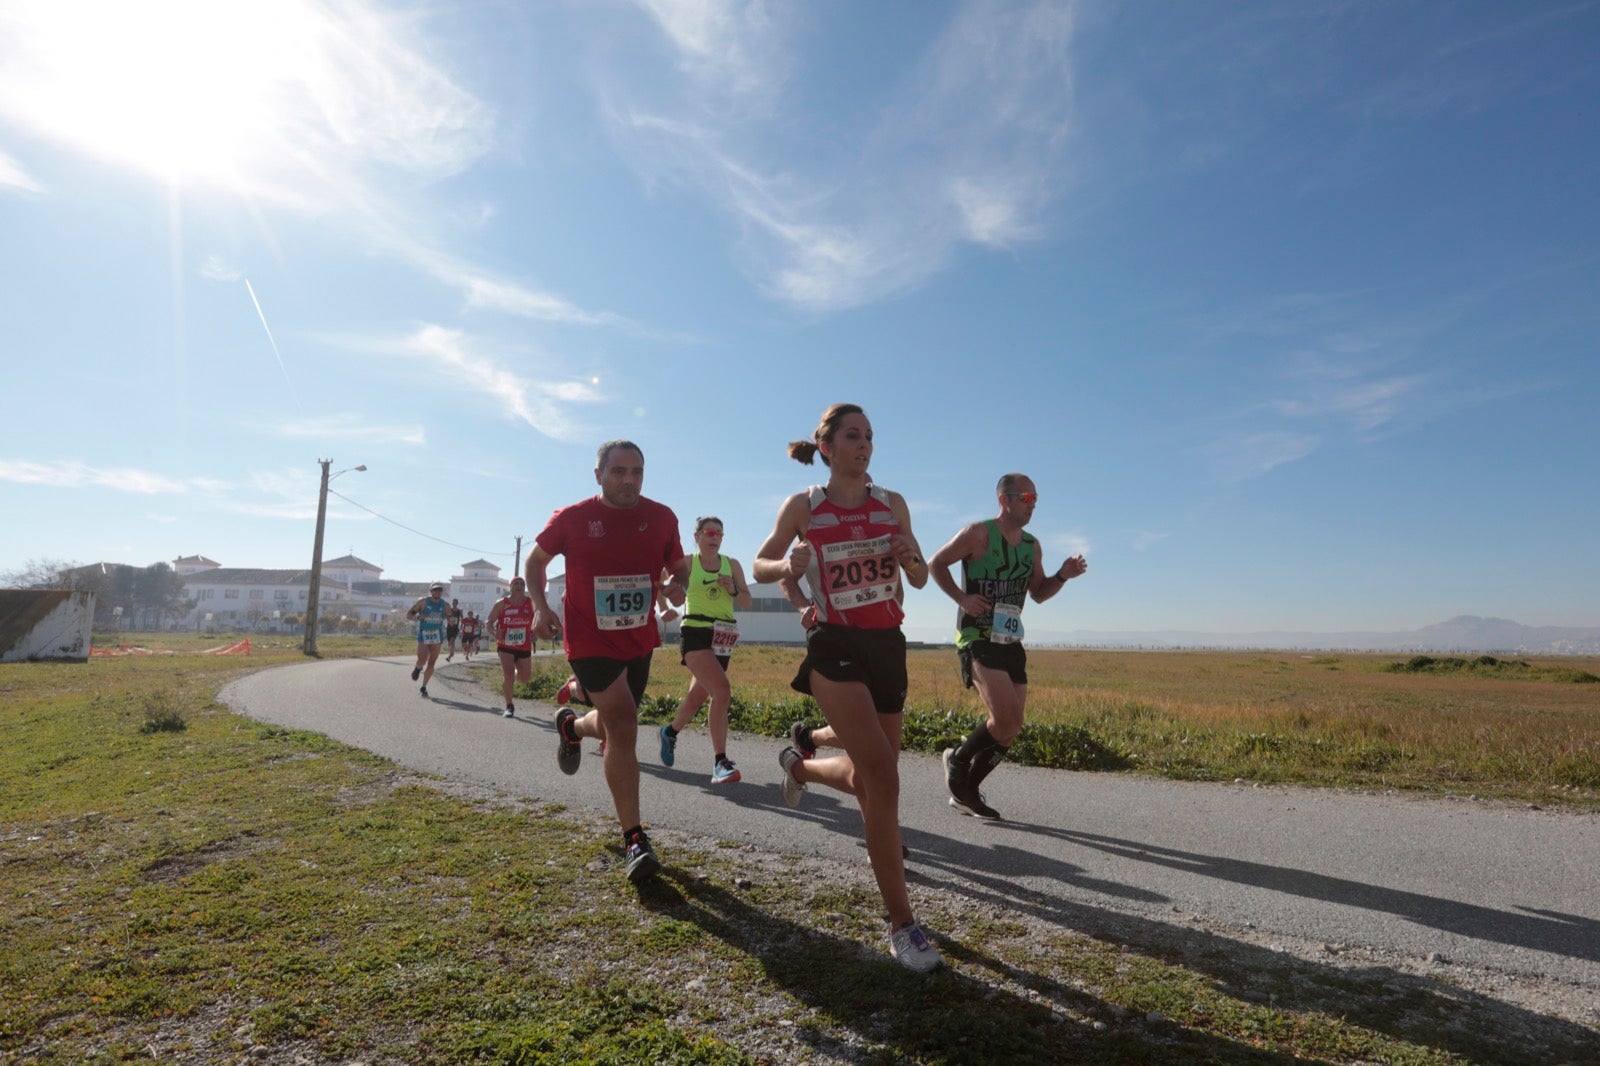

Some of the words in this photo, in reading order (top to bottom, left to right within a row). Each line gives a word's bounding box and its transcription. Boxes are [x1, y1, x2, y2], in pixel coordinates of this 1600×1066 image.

[830, 557, 895, 589] 2035
[606, 592, 644, 612] 159
[1004, 618, 1018, 633] 49
[508, 633, 523, 641] 560
[714, 630, 738, 646] 2219
